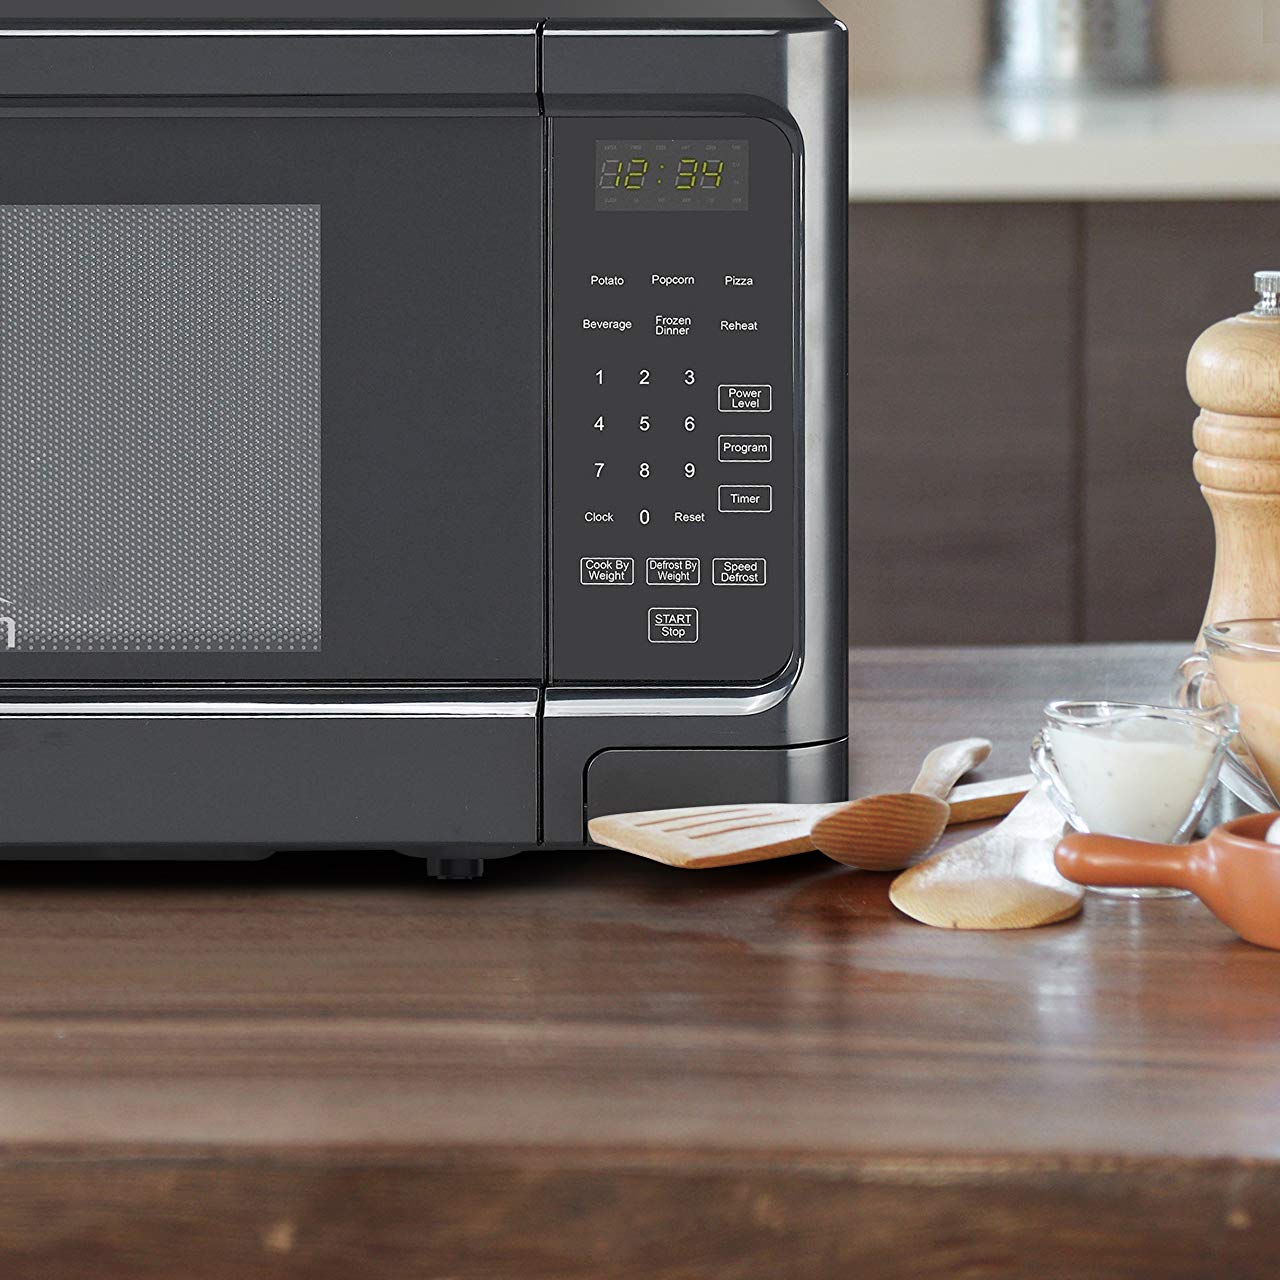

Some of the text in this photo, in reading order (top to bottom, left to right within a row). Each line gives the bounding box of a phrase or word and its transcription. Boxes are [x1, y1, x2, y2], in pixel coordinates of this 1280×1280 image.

[590, 275, 625, 286] Potato
[651, 274, 695, 287] Popcorn
[724, 275, 754, 286] Pizza
[582, 319, 633, 331] Beverage
[655, 315, 692, 325] Frozen
[720, 320, 758, 331] Reheat
[655, 325, 690, 336] Dinner
[595, 369, 603, 385] 1
[639, 369, 650, 385] 2
[684, 369, 696, 385] 3
[728, 388, 762, 398] Power
[731, 398, 760, 409] Level
[593, 415, 605, 432] 4
[639, 415, 651, 432] 5
[684, 416, 696, 432] 6
[723, 443, 768, 455] Program
[594, 462, 605, 478] 7
[639, 462, 650, 478] 8
[684, 462, 696, 479] 9
[730, 493, 761, 504] Timer
[584, 511, 615, 522] Clock
[639, 509, 650, 525] 0
[674, 511, 706, 523] Reset
[585, 560, 630, 572] Cook By
[649, 560, 698, 572] Defrost By
[723, 562, 758, 573] Speed
[588, 571, 625, 581] Weight
[657, 571, 690, 581] Weight
[721, 572, 759, 582] Defrost
[654, 614, 692, 624] START
[661, 627, 686, 638] Stop
